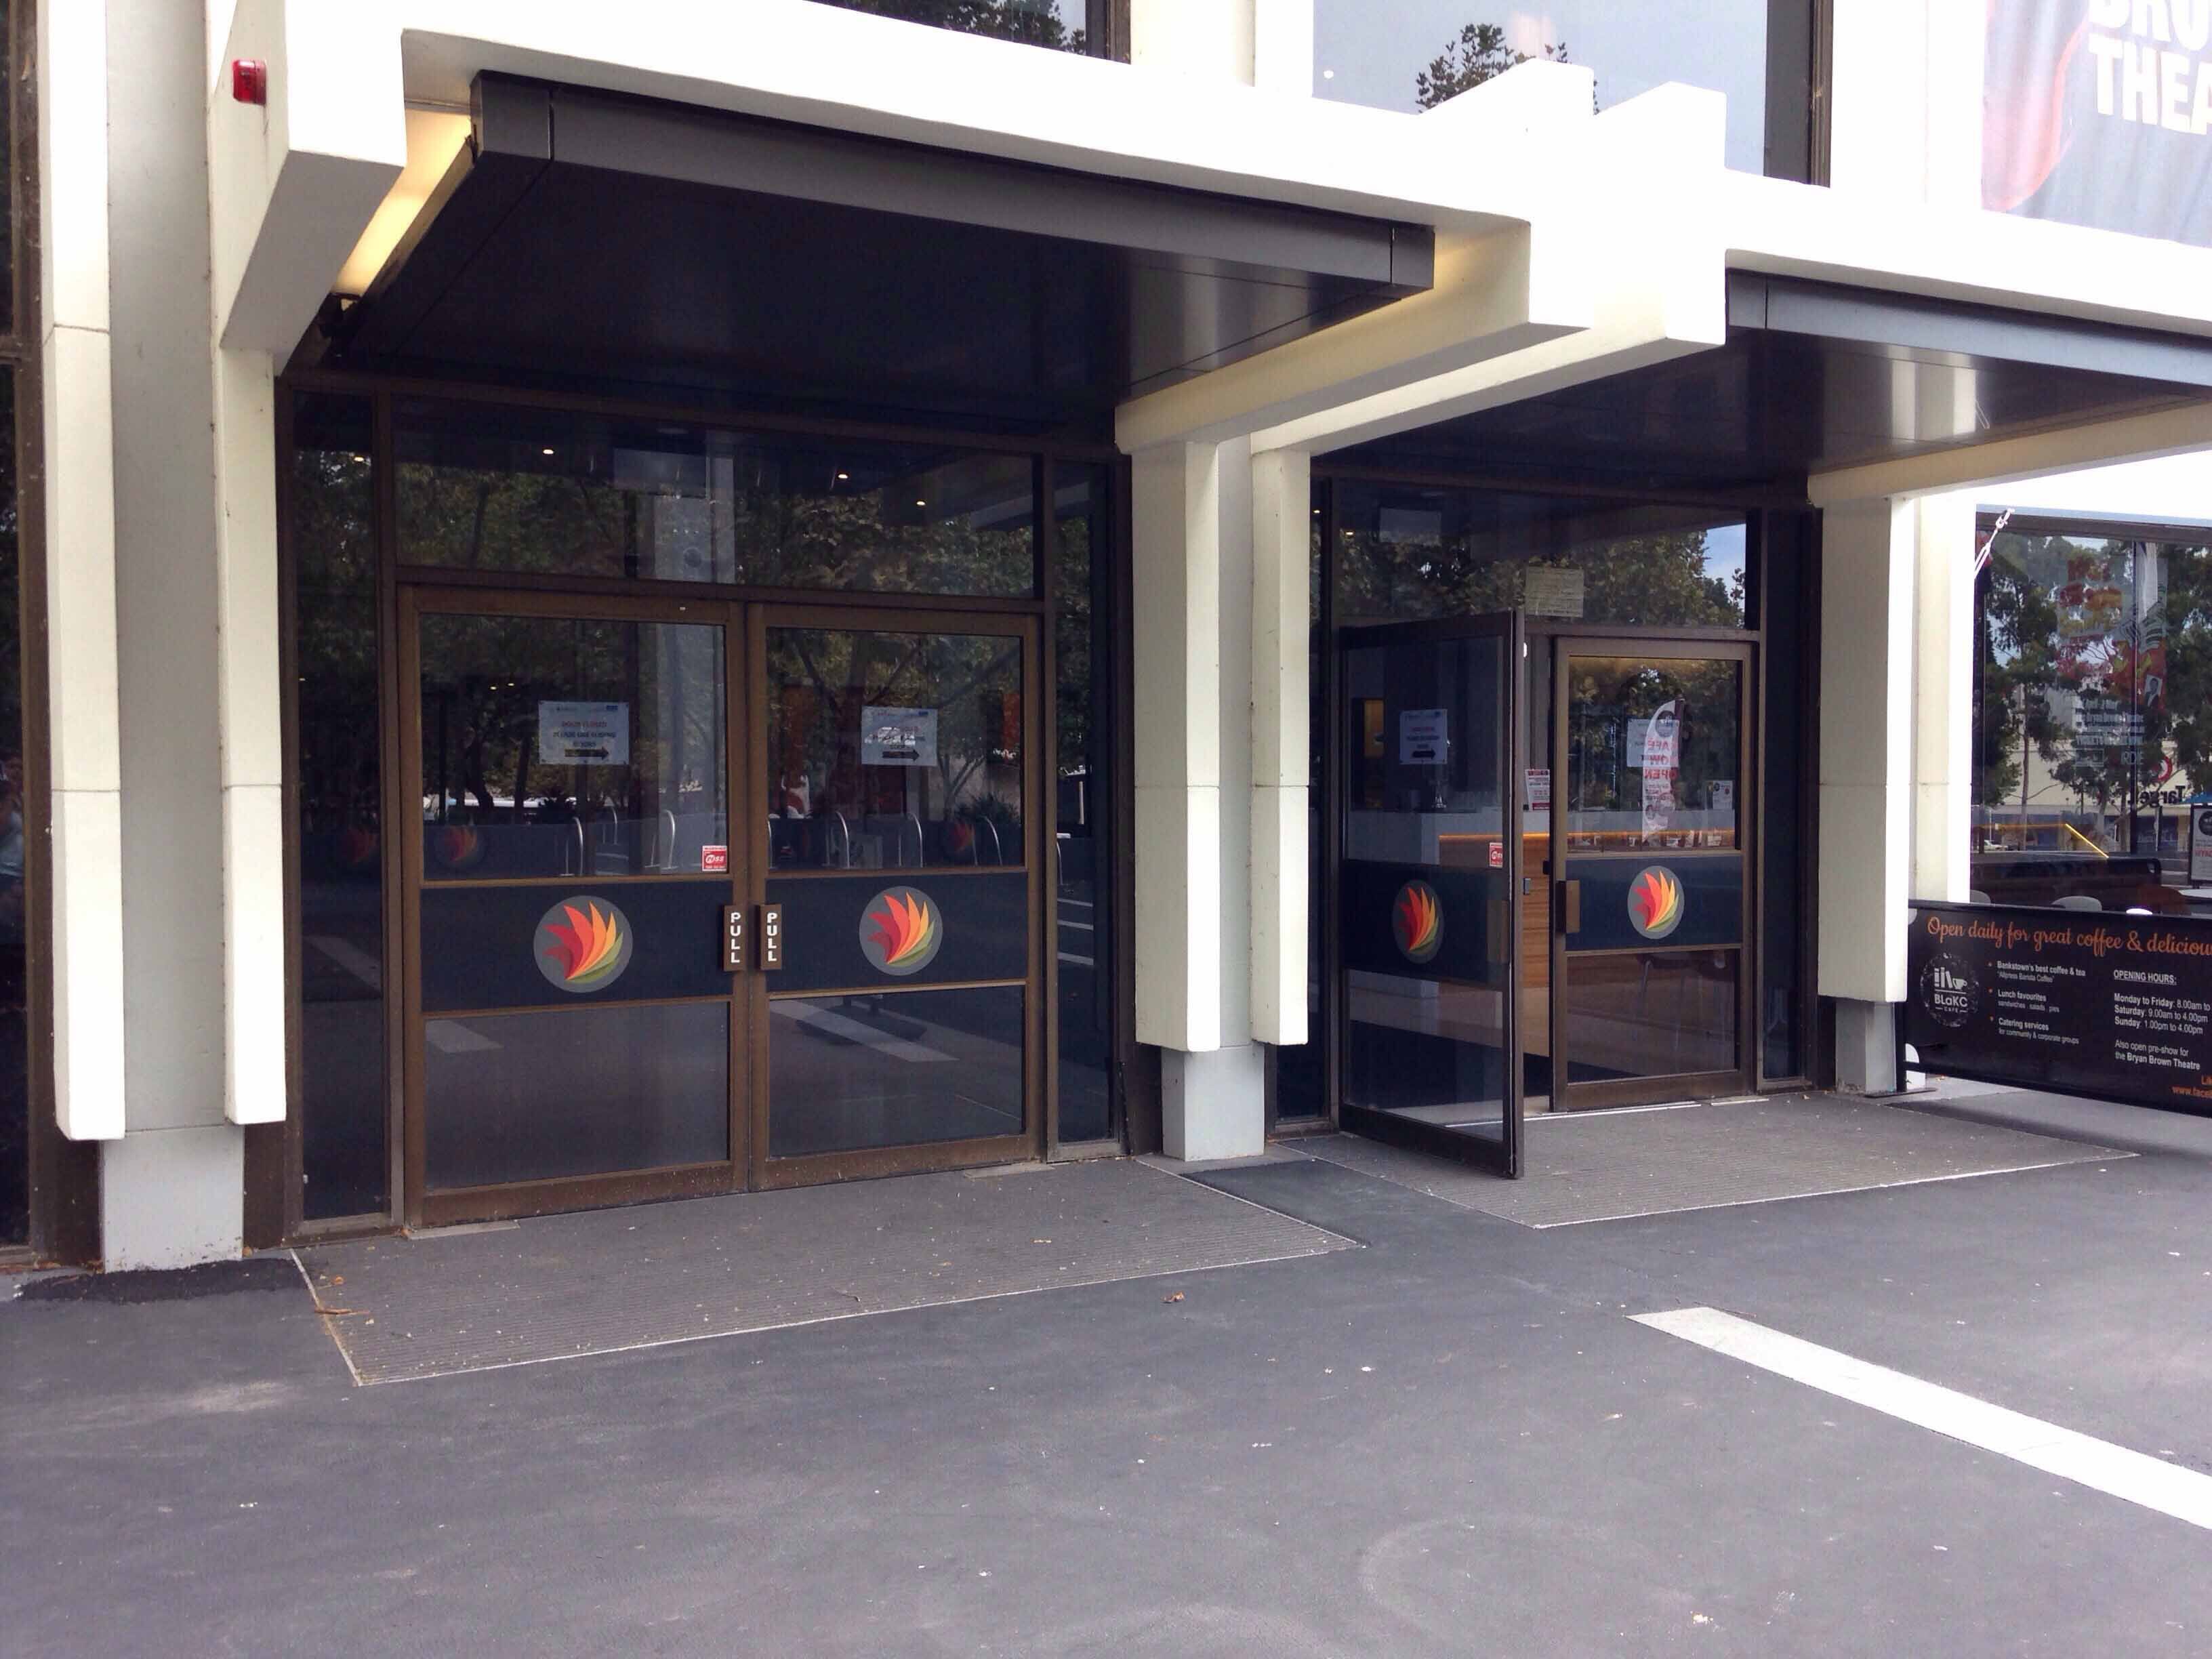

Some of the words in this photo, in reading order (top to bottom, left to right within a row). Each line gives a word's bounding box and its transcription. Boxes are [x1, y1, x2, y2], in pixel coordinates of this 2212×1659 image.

[730, 912, 741, 963] PULL
[766, 912, 777, 962] PULL
[1927, 917, 1963, 943] Open
[1968, 920, 2003, 948] daily
[2007, 922, 2028, 948] for
[2033, 928, 2072, 951] great
[2076, 928, 2123, 956] coffee
[2126, 930, 2144, 952] &
[2035, 965, 2049, 973] best
[2049, 966, 2068, 975] coffee
[2114, 970, 2146, 981] OPENING
[2148, 972, 2177, 985] HOURS:
[1998, 989, 2016, 998] Lunch
[2114, 993, 2141, 1006] Monday
[2142, 995, 2150, 1004] to
[2203, 1003, 2211, 1011] to
[2174, 1011, 2181, 1020] to
[1999, 1018, 2024, 1029] Catering
[2024, 1021, 2049, 1031] services
[2169, 1023, 2176, 1031] to
[2114, 1039, 2129, 1049] Also
[2130, 1043, 2147, 1052] open
[2148, 1044, 2178, 1055] pre-show
[2179, 1047, 2189, 1057] for
[2115, 1051, 2126, 1060] the
[2127, 1052, 2147, 1064] Bryan
[2149, 1055, 2171, 1066] Brown
[2173, 1058, 2200, 1070] Theatre
